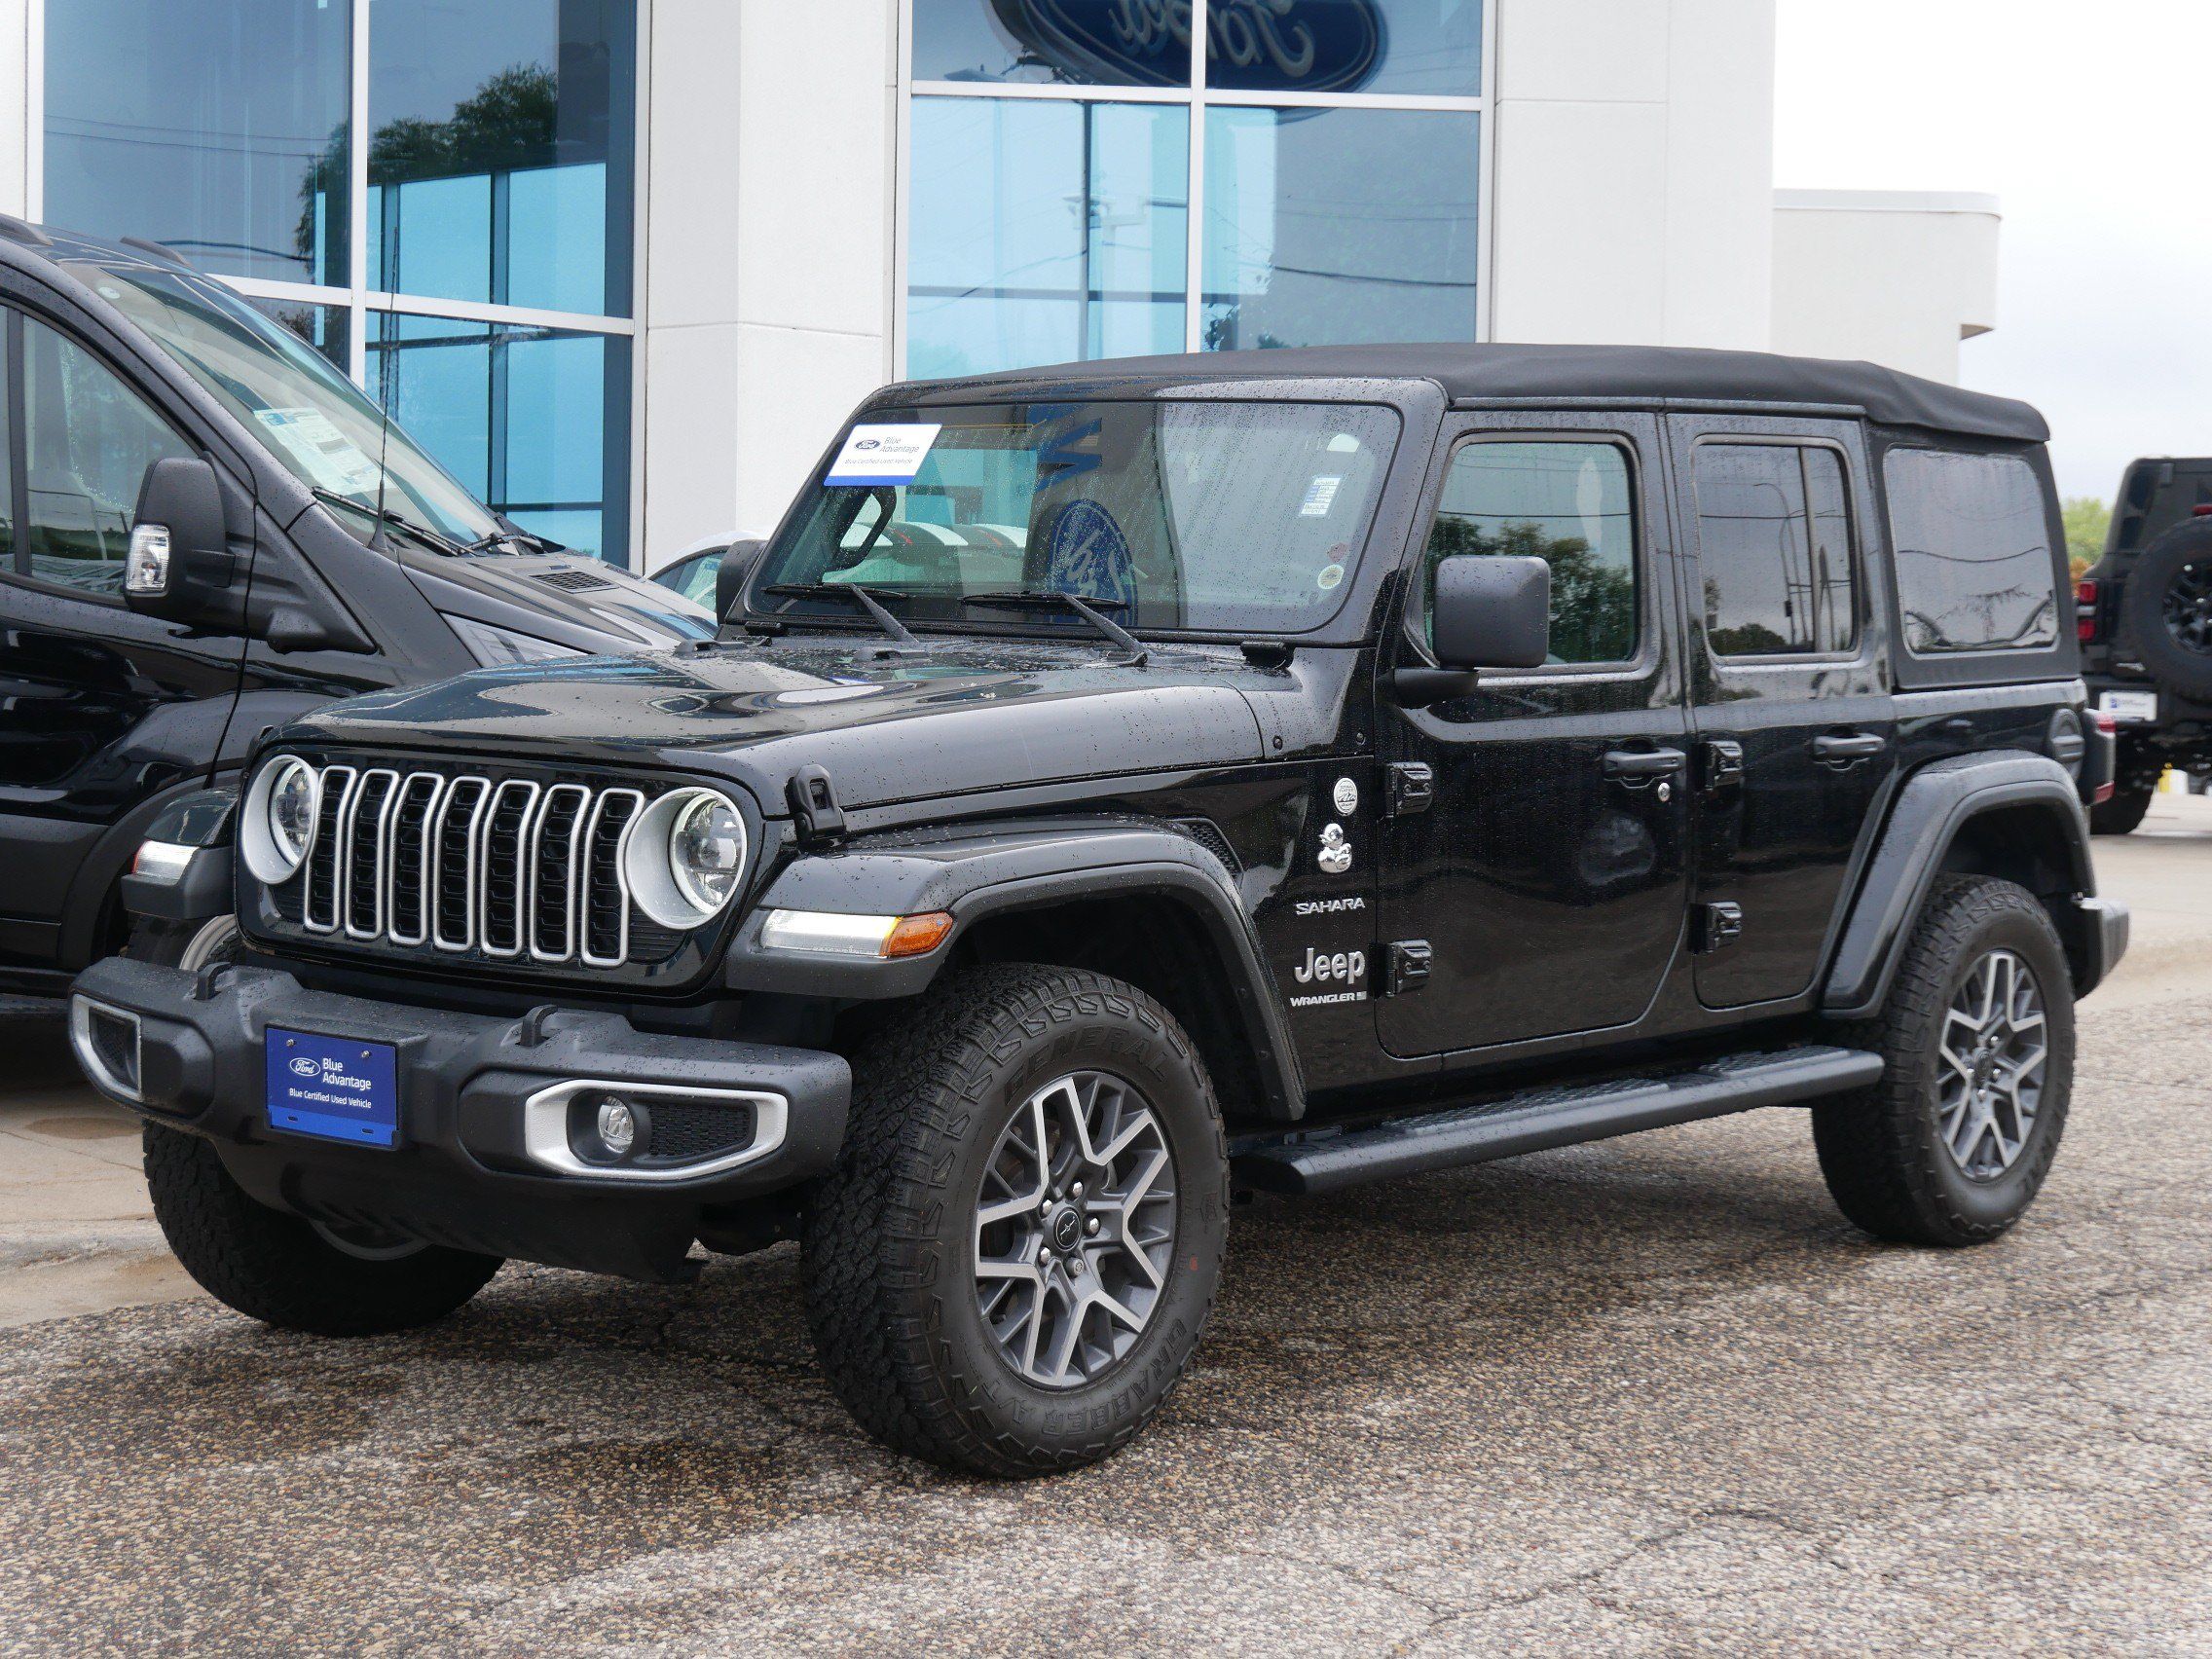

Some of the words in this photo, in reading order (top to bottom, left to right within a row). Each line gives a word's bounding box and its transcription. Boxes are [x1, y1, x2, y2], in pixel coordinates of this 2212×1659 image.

[879, 445, 920, 454] Advantage
[1295, 897, 1366, 915] SAHARA
[1294, 947, 1366, 985] Jeep
[1289, 992, 1356, 1008] WRANGLER
[295, 1059, 315, 1074] Ford
[322, 1057, 344, 1071] Blue
[322, 1072, 372, 1090] Advantage
[289, 1088, 303, 1098] Blue
[304, 1089, 330, 1102] Certified
[330, 1094, 348, 1105] Used
[348, 1096, 372, 1109] Vehicle
